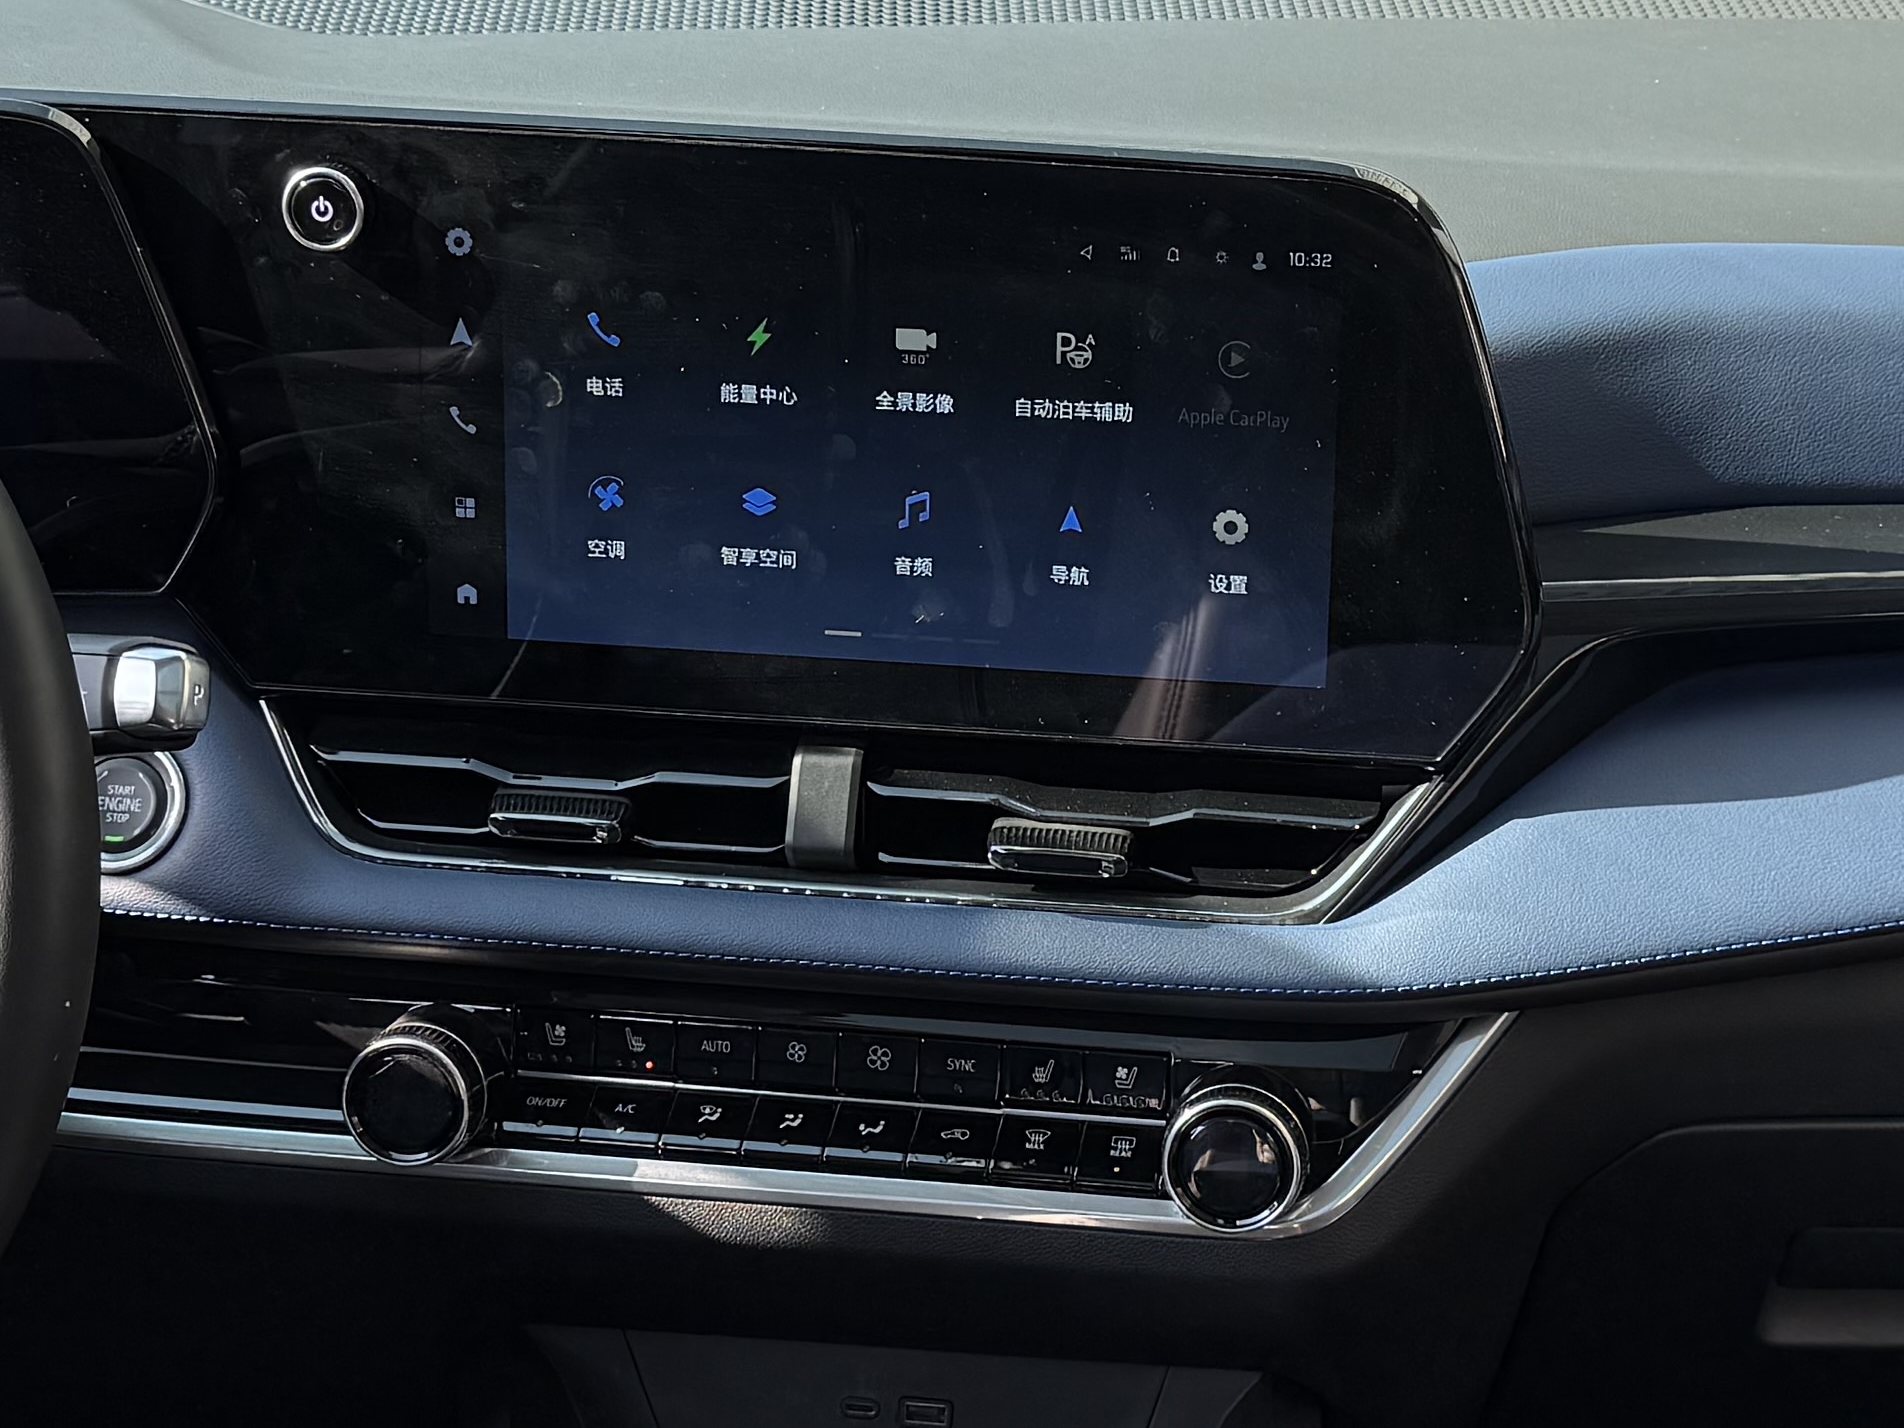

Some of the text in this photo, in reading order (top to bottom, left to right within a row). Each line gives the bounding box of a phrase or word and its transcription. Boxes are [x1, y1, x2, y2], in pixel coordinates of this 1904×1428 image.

[1288, 250, 1333, 269] 10:32
[585, 375, 624, 398] 电话
[720, 381, 799, 407] 能量中心
[875, 389, 955, 415] 全景影像
[1013, 396, 1134, 424] 自动泊车辅助
[1177, 407, 1290, 434] Apple CarPlay
[587, 538, 626, 562] 空调
[720, 546, 799, 571] 智享空间
[894, 556, 934, 578] 音频
[1049, 564, 1090, 587] 导航
[1208, 573, 1249, 596] 设置
[107, 784, 136, 796] START
[97, 795, 143, 813] ENGINE
[105, 812, 130, 823] STOP
[701, 1039, 731, 1054] AUTO
[946, 1058, 976, 1073] SYNC
[525, 1095, 568, 1110] ON/OFF
[613, 1102, 636, 1115] A/C
